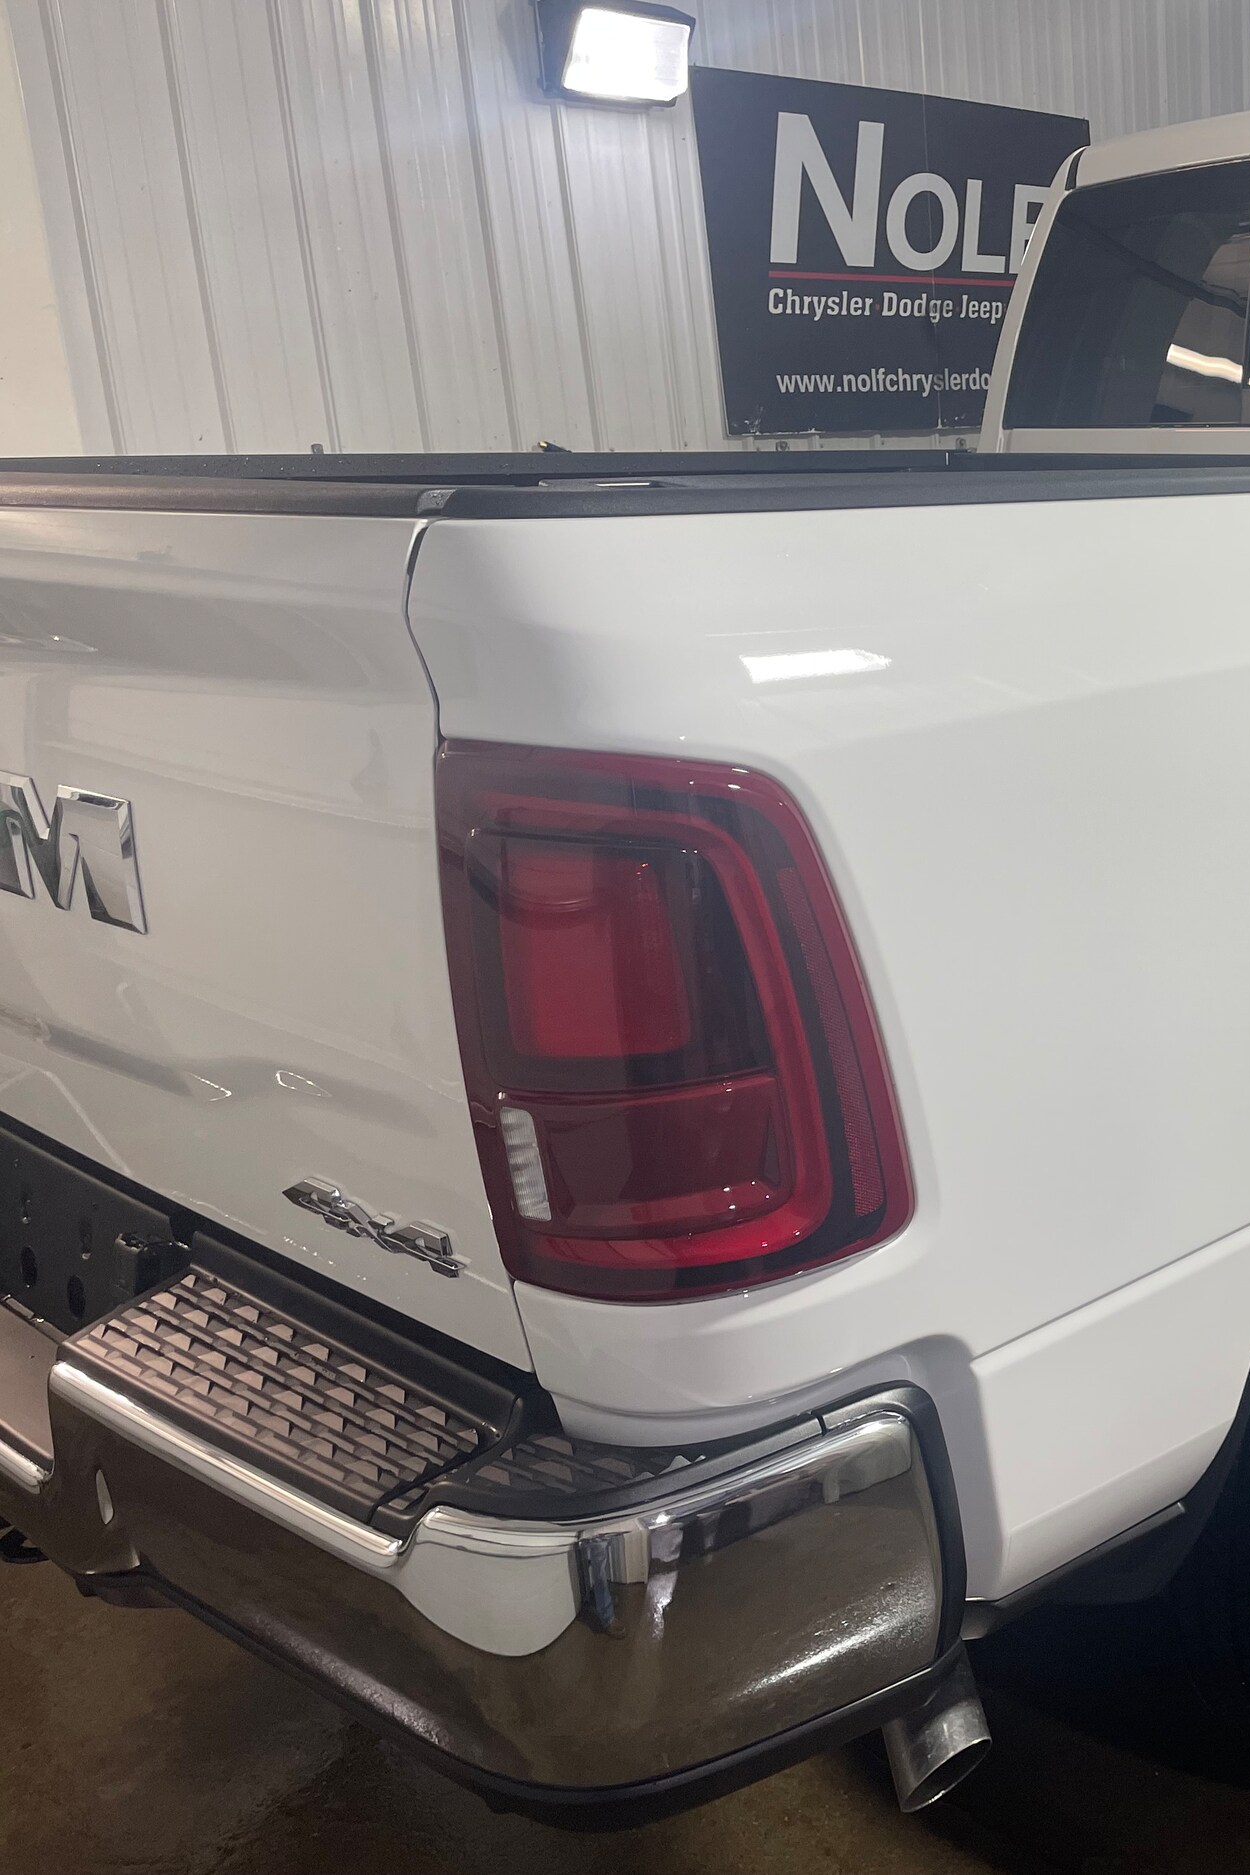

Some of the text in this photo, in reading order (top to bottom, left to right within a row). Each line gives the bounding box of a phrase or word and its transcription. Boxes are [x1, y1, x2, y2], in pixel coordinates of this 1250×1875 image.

[768, 288, 1003, 324] Chrysler Dodge Jeep
